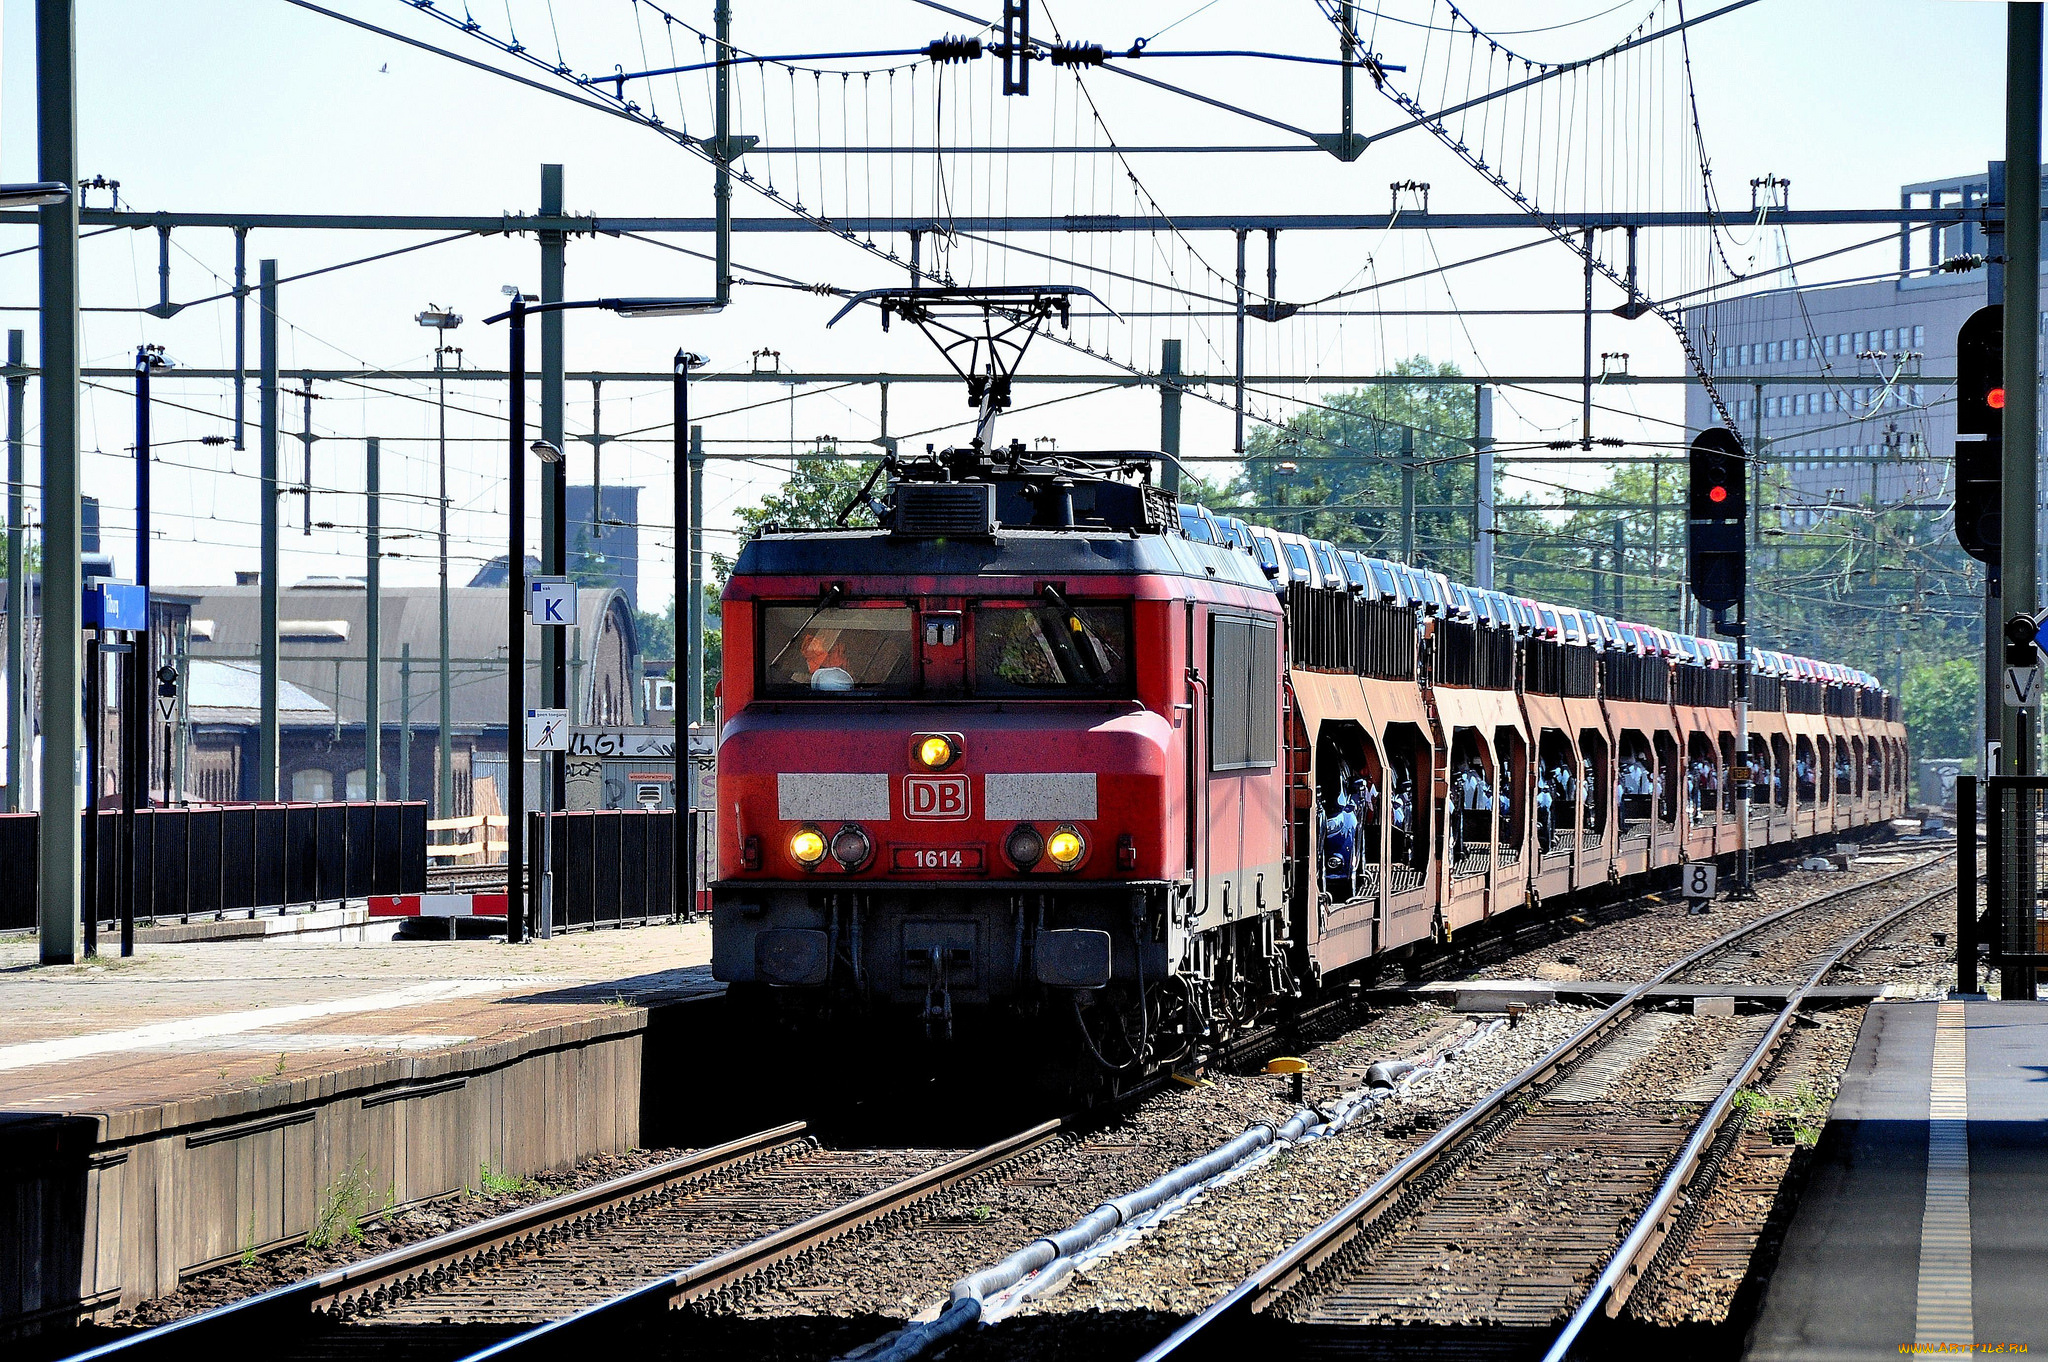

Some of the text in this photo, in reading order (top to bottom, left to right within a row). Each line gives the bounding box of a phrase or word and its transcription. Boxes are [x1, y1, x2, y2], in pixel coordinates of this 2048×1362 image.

[545, 598, 564, 621] K
[2008, 668, 2037, 703] V
[158, 699, 176, 720] V
[913, 783, 962, 813] DB
[915, 850, 962, 868] 1614
[1690, 866, 1709, 894] 8
